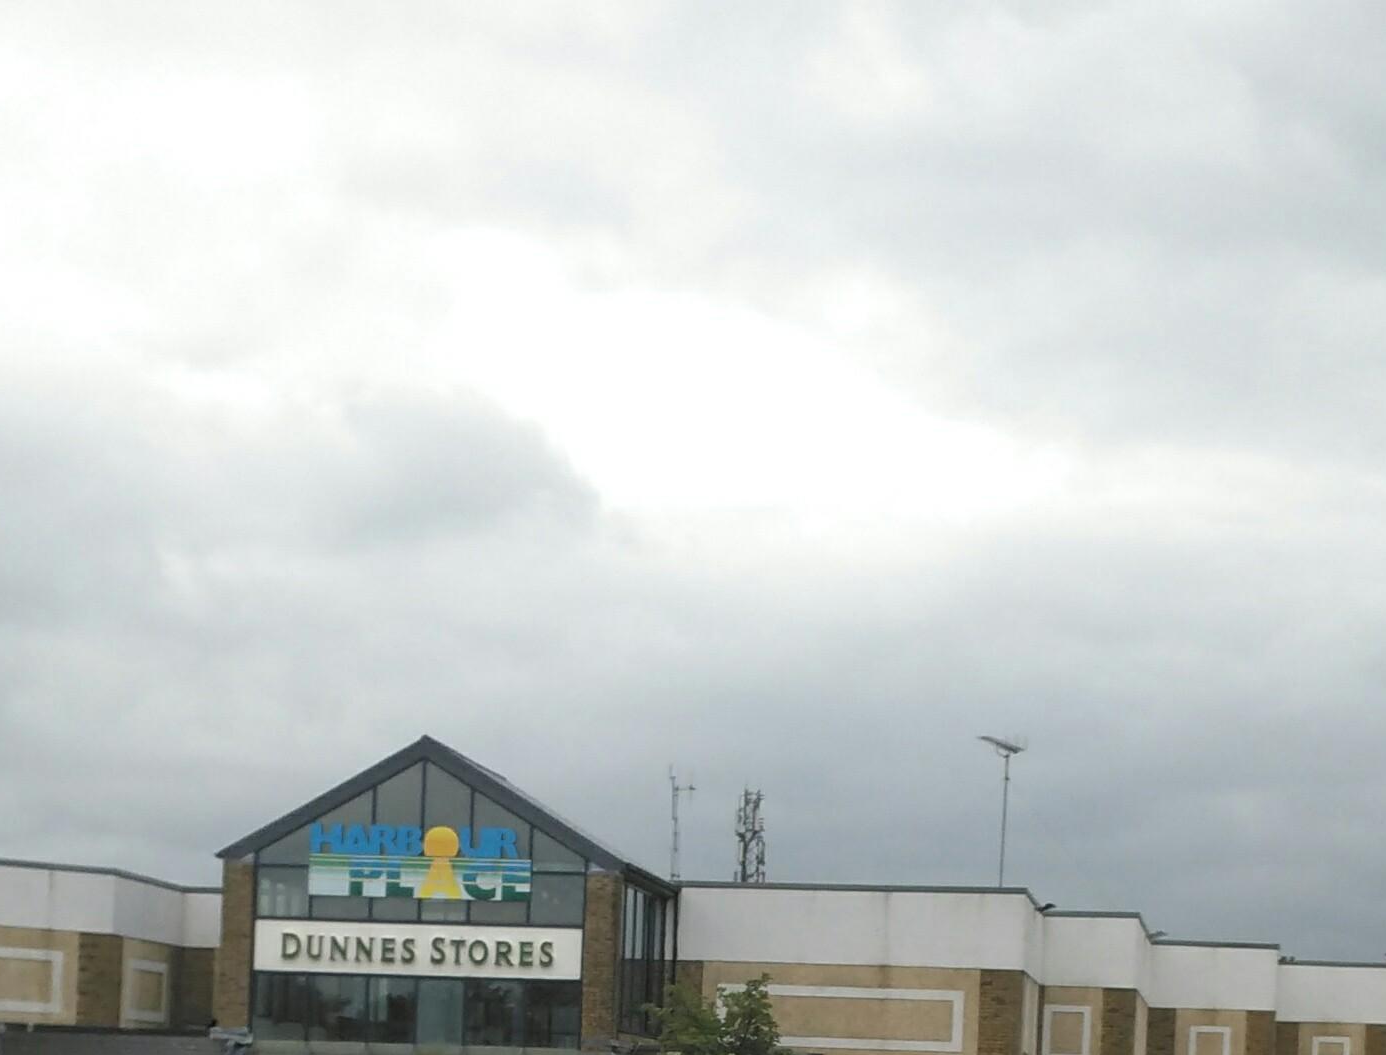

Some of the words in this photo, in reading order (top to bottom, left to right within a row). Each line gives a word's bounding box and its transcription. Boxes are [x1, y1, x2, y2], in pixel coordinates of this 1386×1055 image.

[309, 822, 518, 859] HARBOUR
[281, 932, 417, 964] DUNNES
[430, 937, 555, 967] STORES
